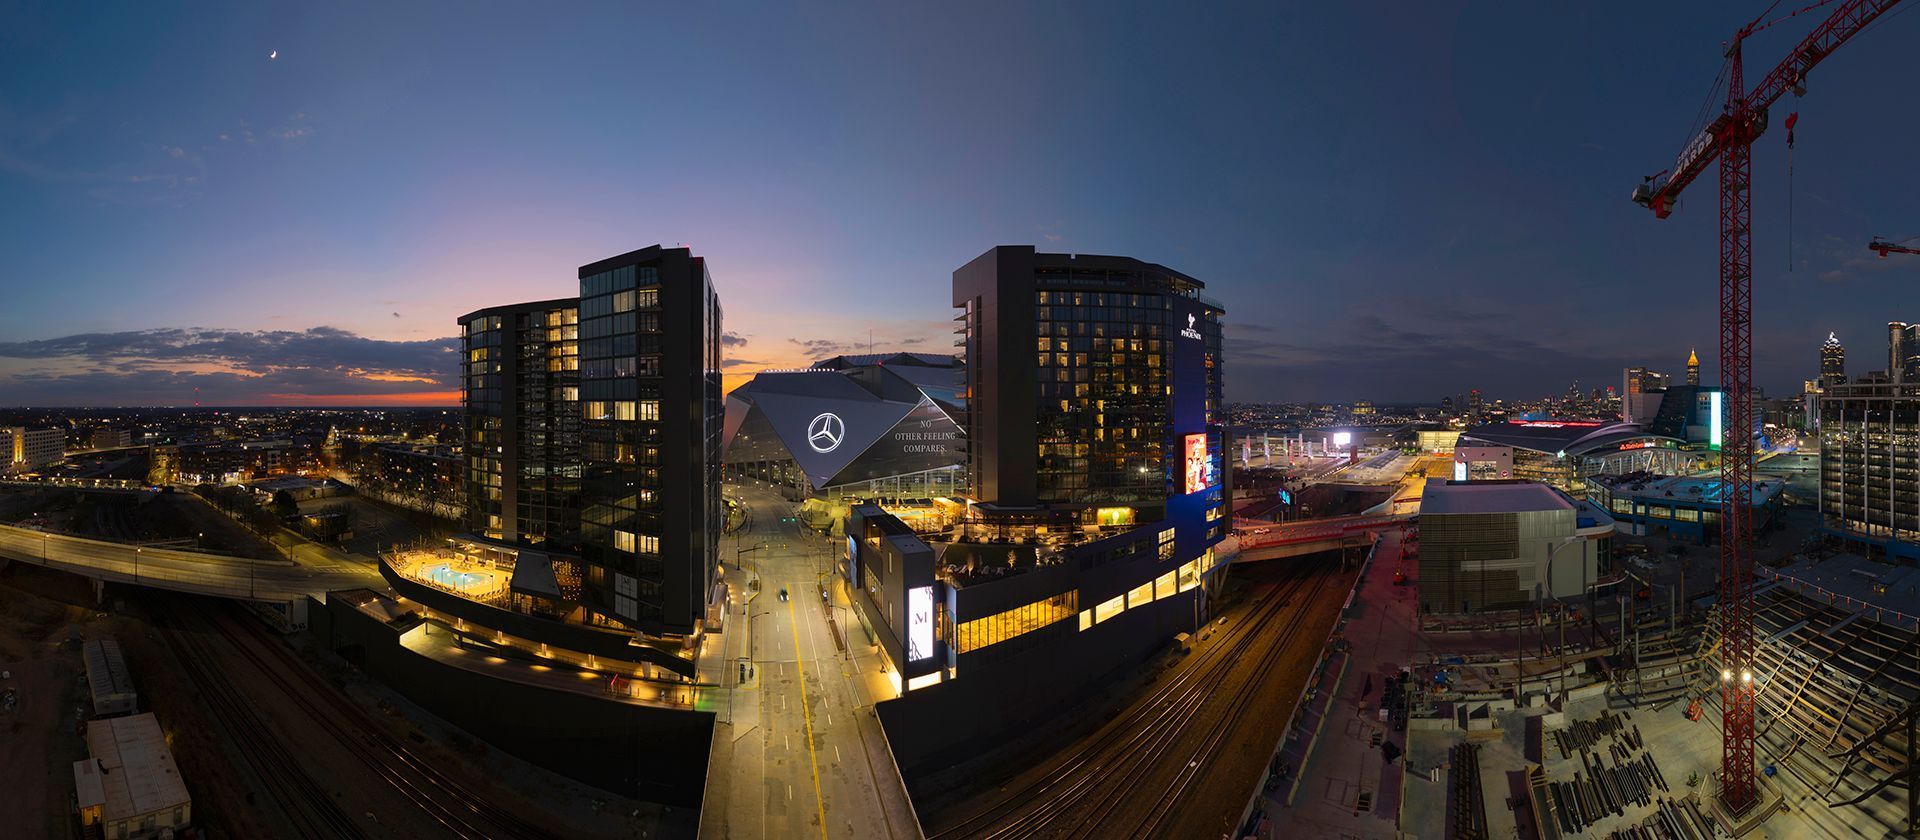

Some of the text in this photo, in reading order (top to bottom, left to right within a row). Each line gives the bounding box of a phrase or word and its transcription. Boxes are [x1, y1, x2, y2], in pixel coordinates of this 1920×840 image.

[1679, 133, 1714, 174] YARDS
[895, 432, 956, 440] OTHER FEELING
[915, 611, 927, 625] M
